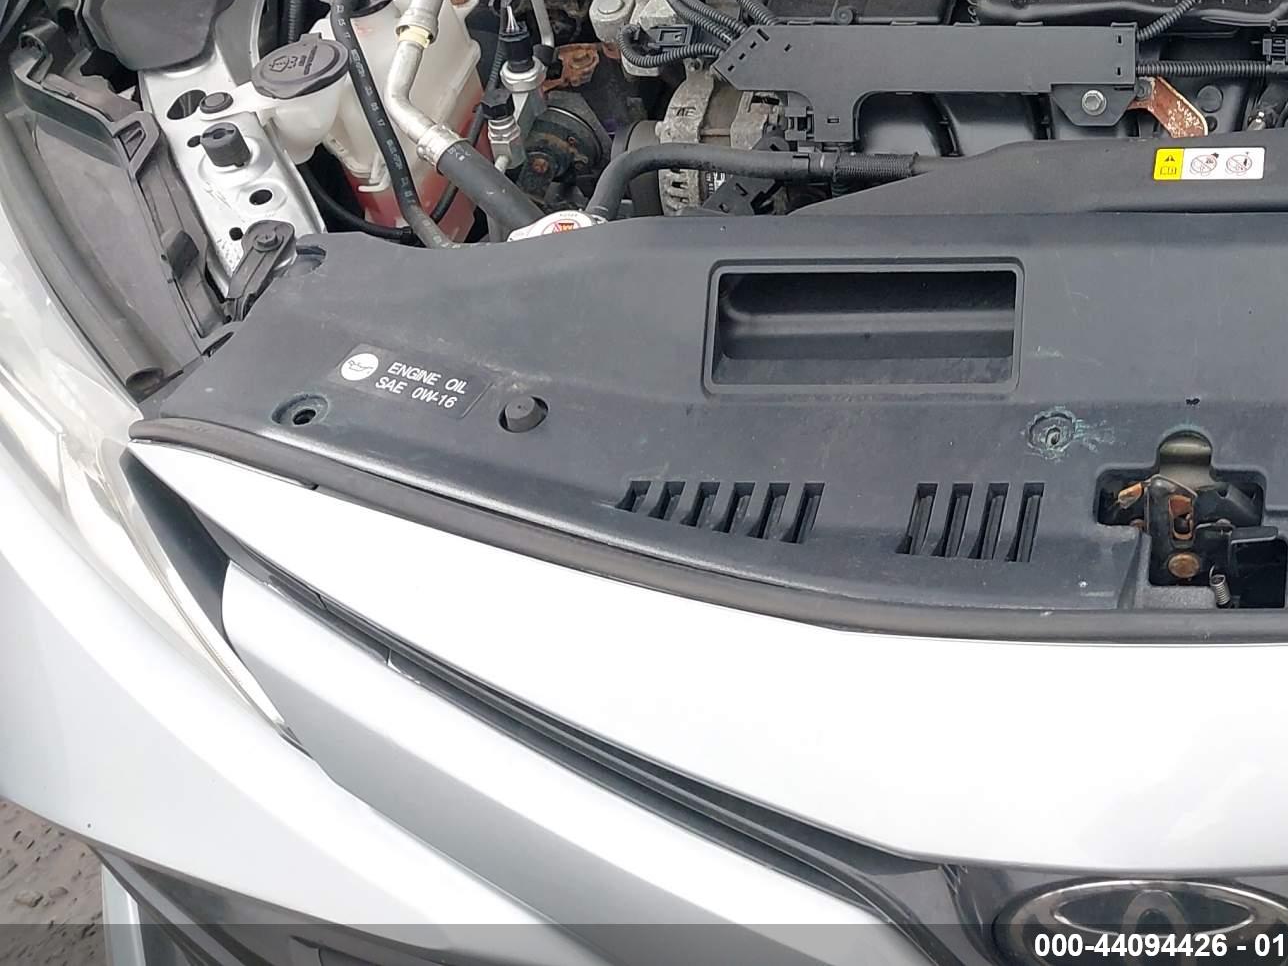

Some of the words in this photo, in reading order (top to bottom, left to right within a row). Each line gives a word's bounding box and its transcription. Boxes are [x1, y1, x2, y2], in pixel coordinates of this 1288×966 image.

[375, 377, 407, 393] SAE
[411, 387, 457, 408] 0W-16
[388, 362, 441, 385] ENGINE
[445, 378, 467, 394] OIL
